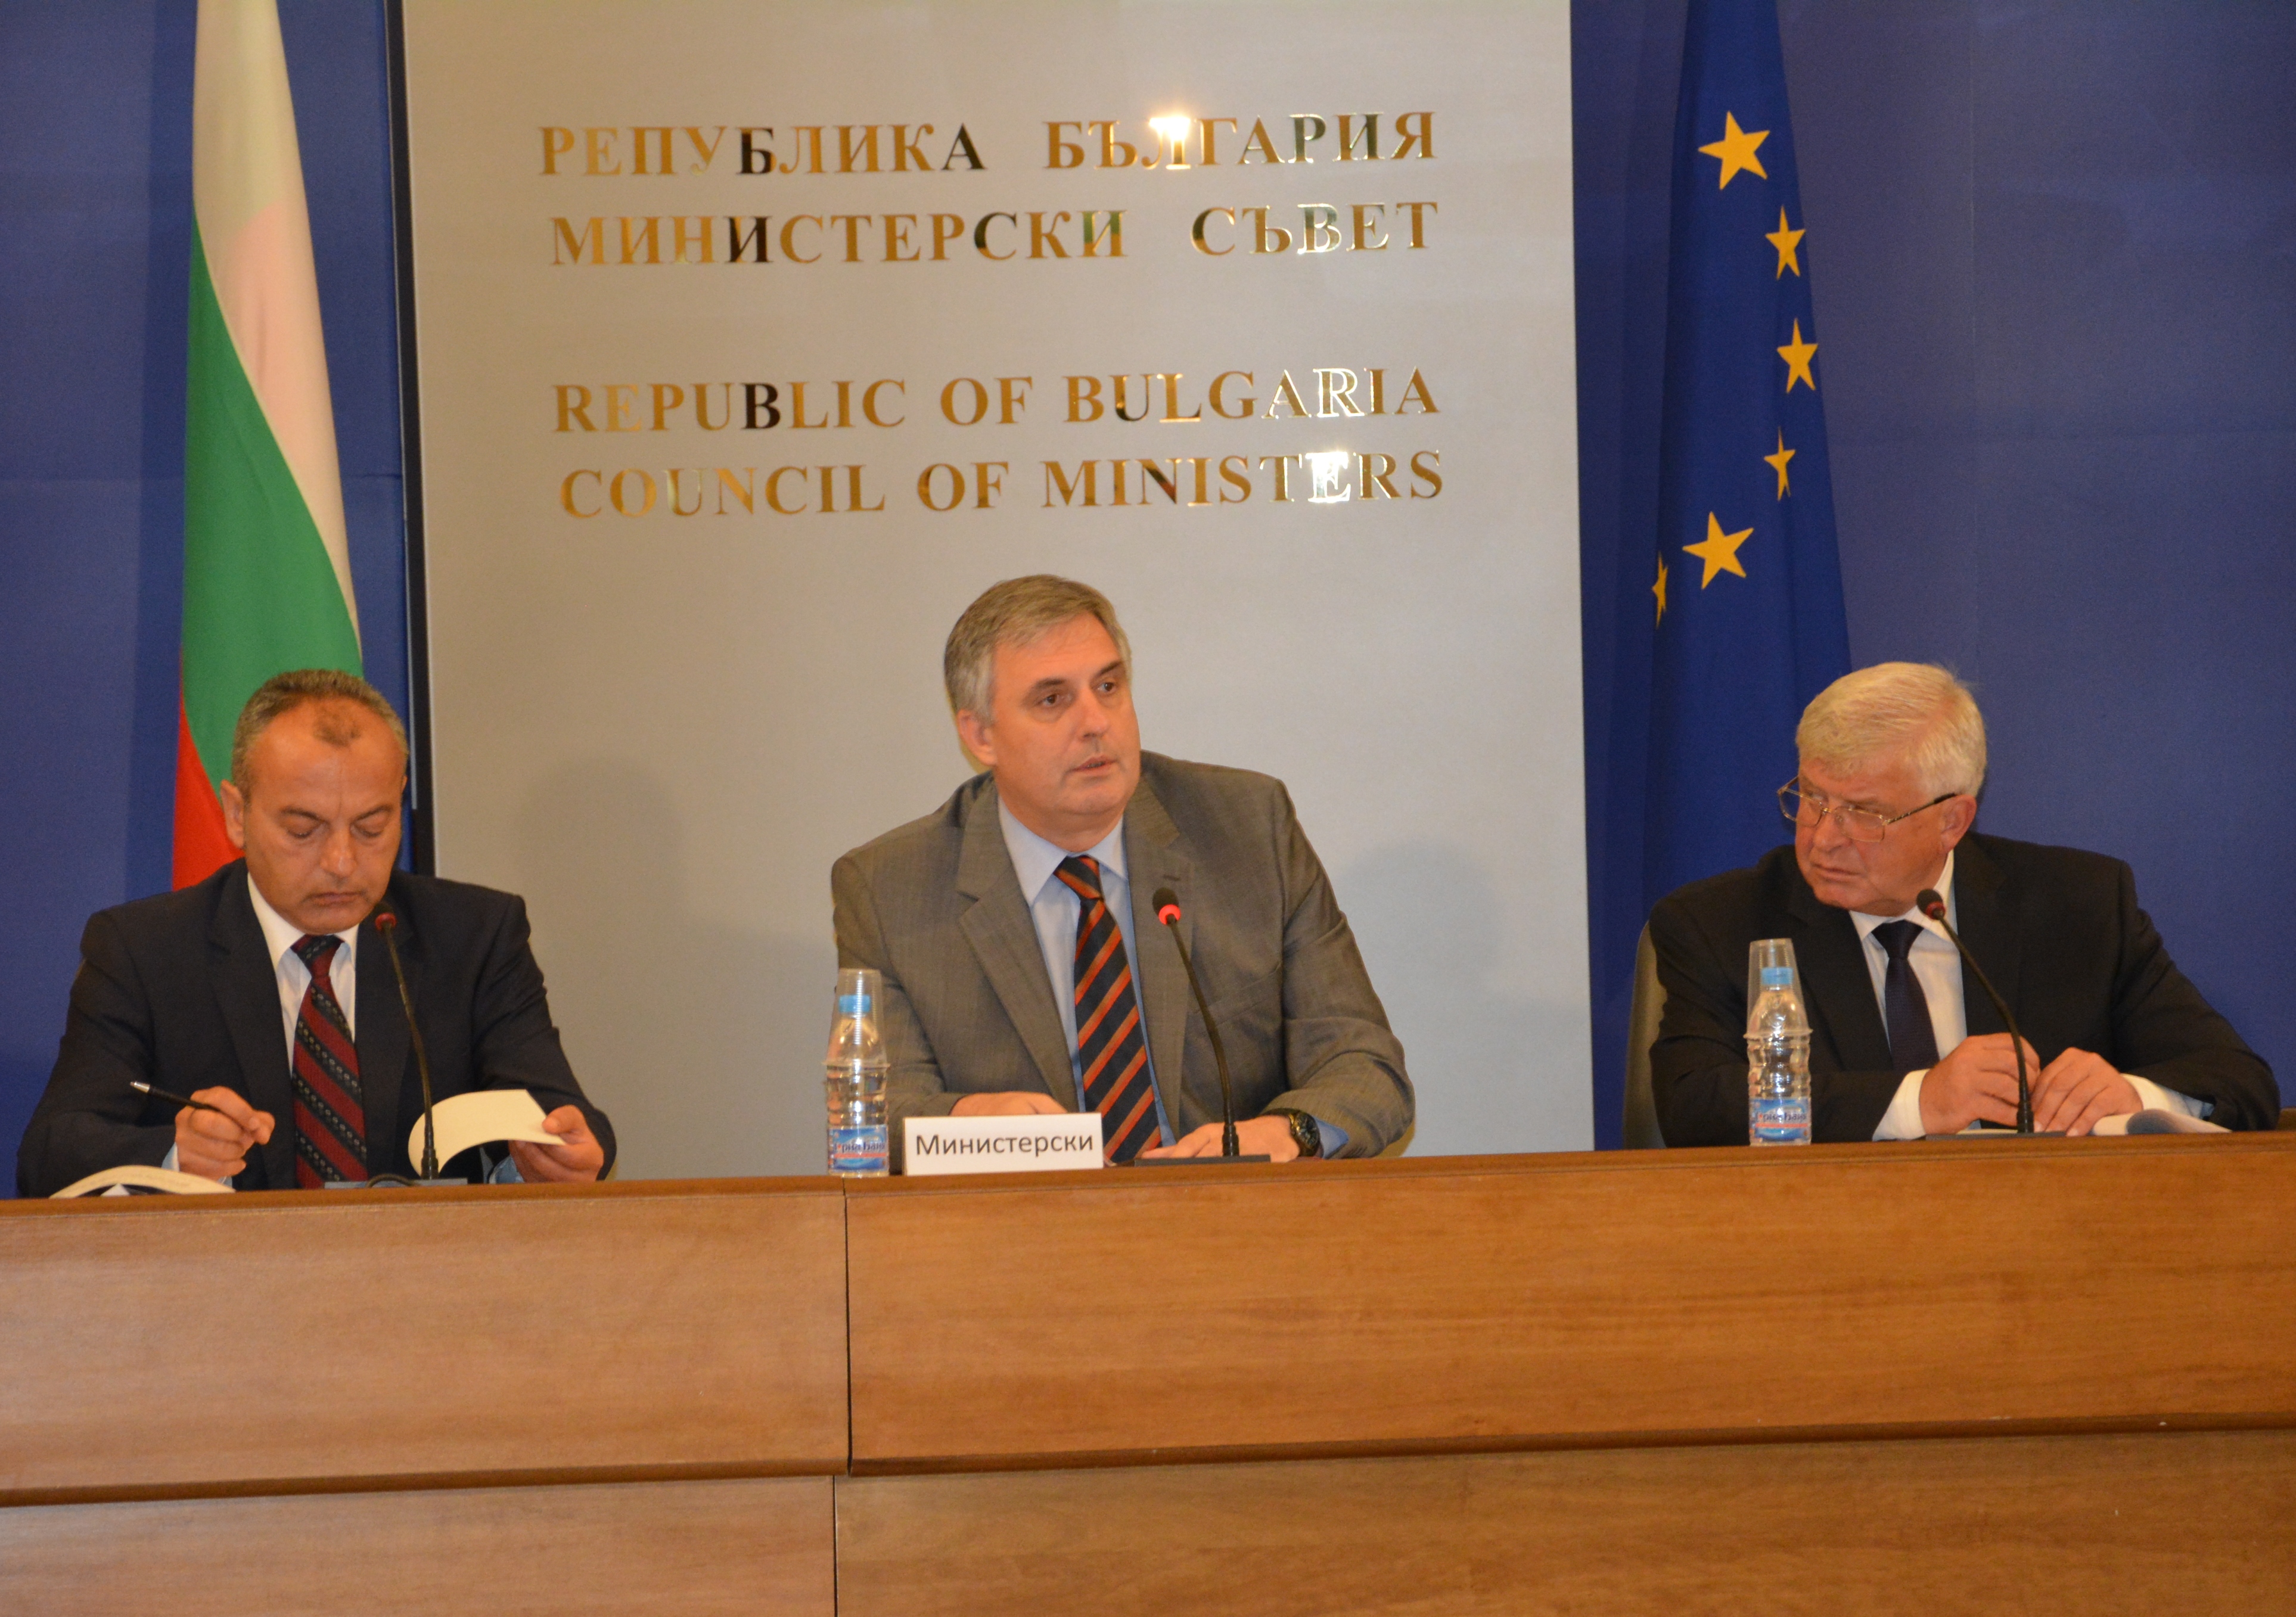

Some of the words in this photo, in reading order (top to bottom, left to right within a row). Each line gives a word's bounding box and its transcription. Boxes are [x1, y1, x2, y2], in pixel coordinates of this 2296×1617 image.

[538, 123, 988, 175] РЕПУБЛИКА
[1042, 111, 1437, 170] БЪЛГАРИЯ
[549, 209, 1129, 265] МИНИСТЕРСКИ
[1191, 201, 1439, 255] СЪВЕТ
[551, 378, 906, 433] REPUBLIC
[939, 376, 1033, 427] OF
[1062, 366, 1441, 423] BULGARIA
[560, 464, 886, 518] COUNCIL
[916, 461, 1009, 512] OF
[1041, 450, 1443, 508] MINISTERS
[915, 1134, 1094, 1158] Министерски
